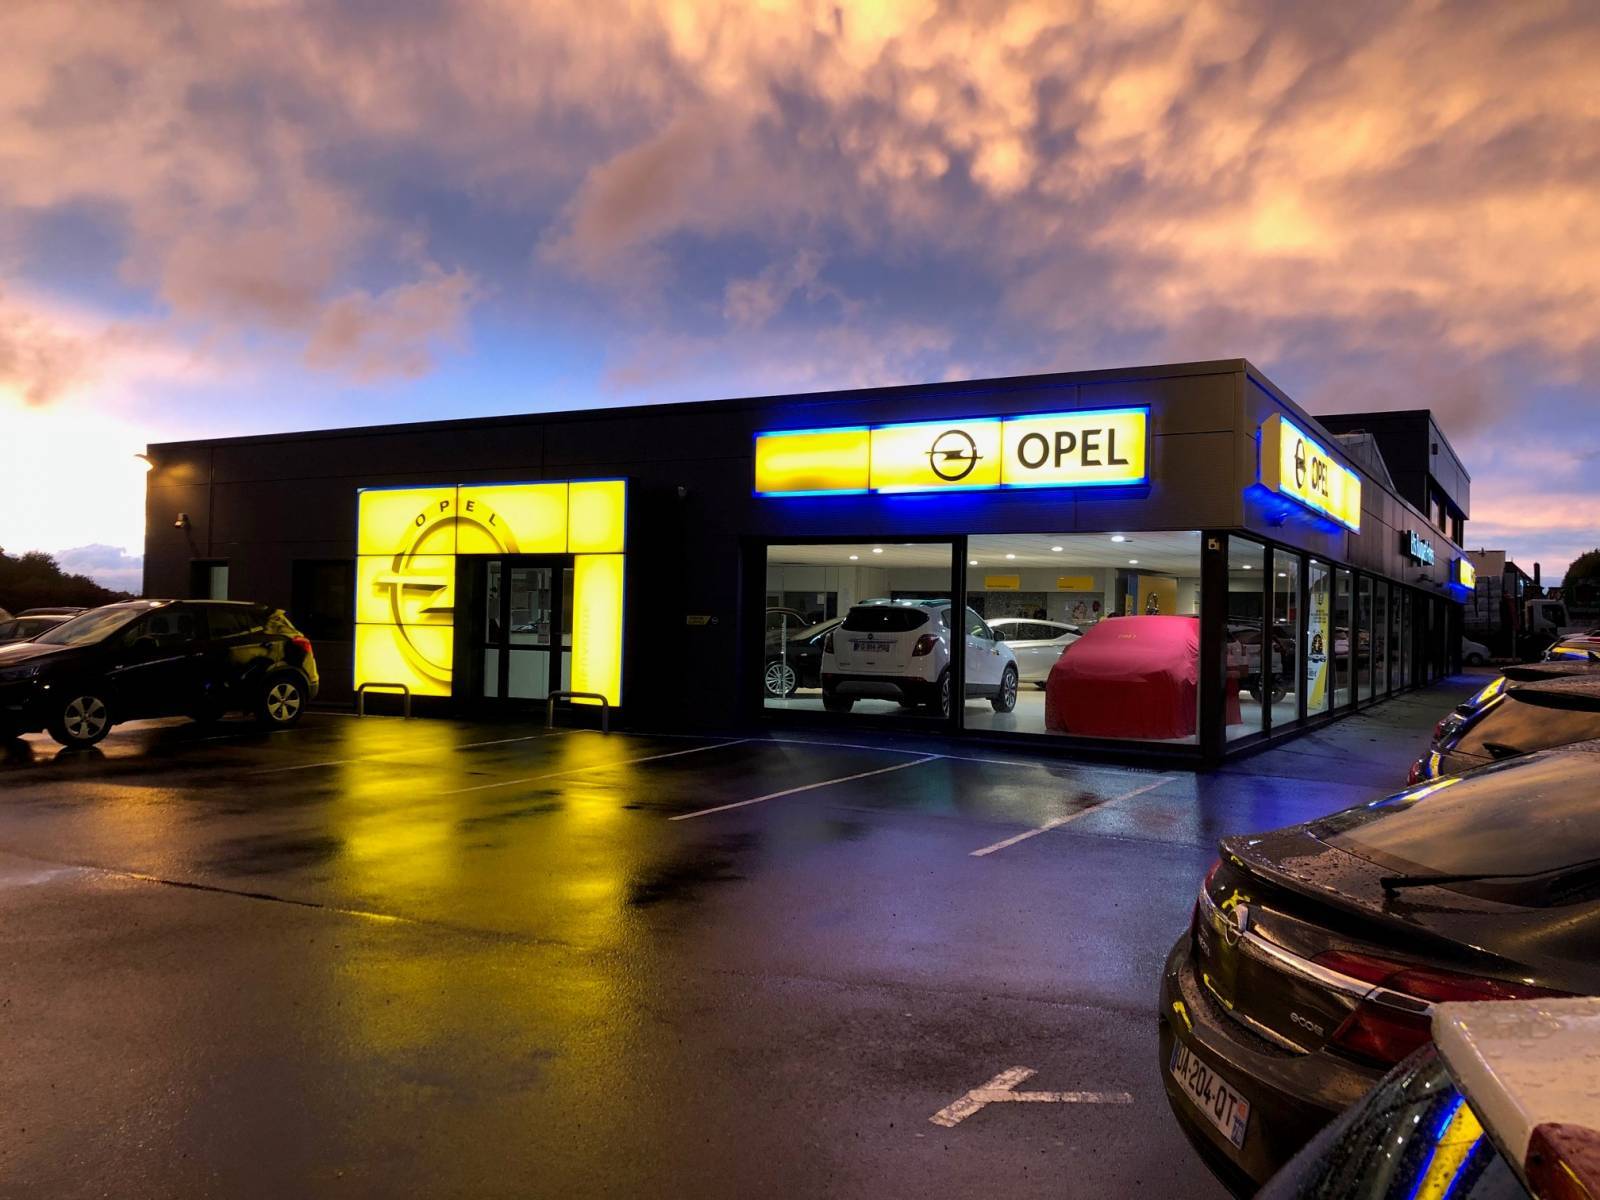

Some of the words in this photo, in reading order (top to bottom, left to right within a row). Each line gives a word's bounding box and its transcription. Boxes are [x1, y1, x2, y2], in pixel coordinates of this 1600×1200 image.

[1017, 428, 1130, 470] OPEL
[1312, 456, 1329, 498] OPEL
[415, 499, 496, 528] OPEL
